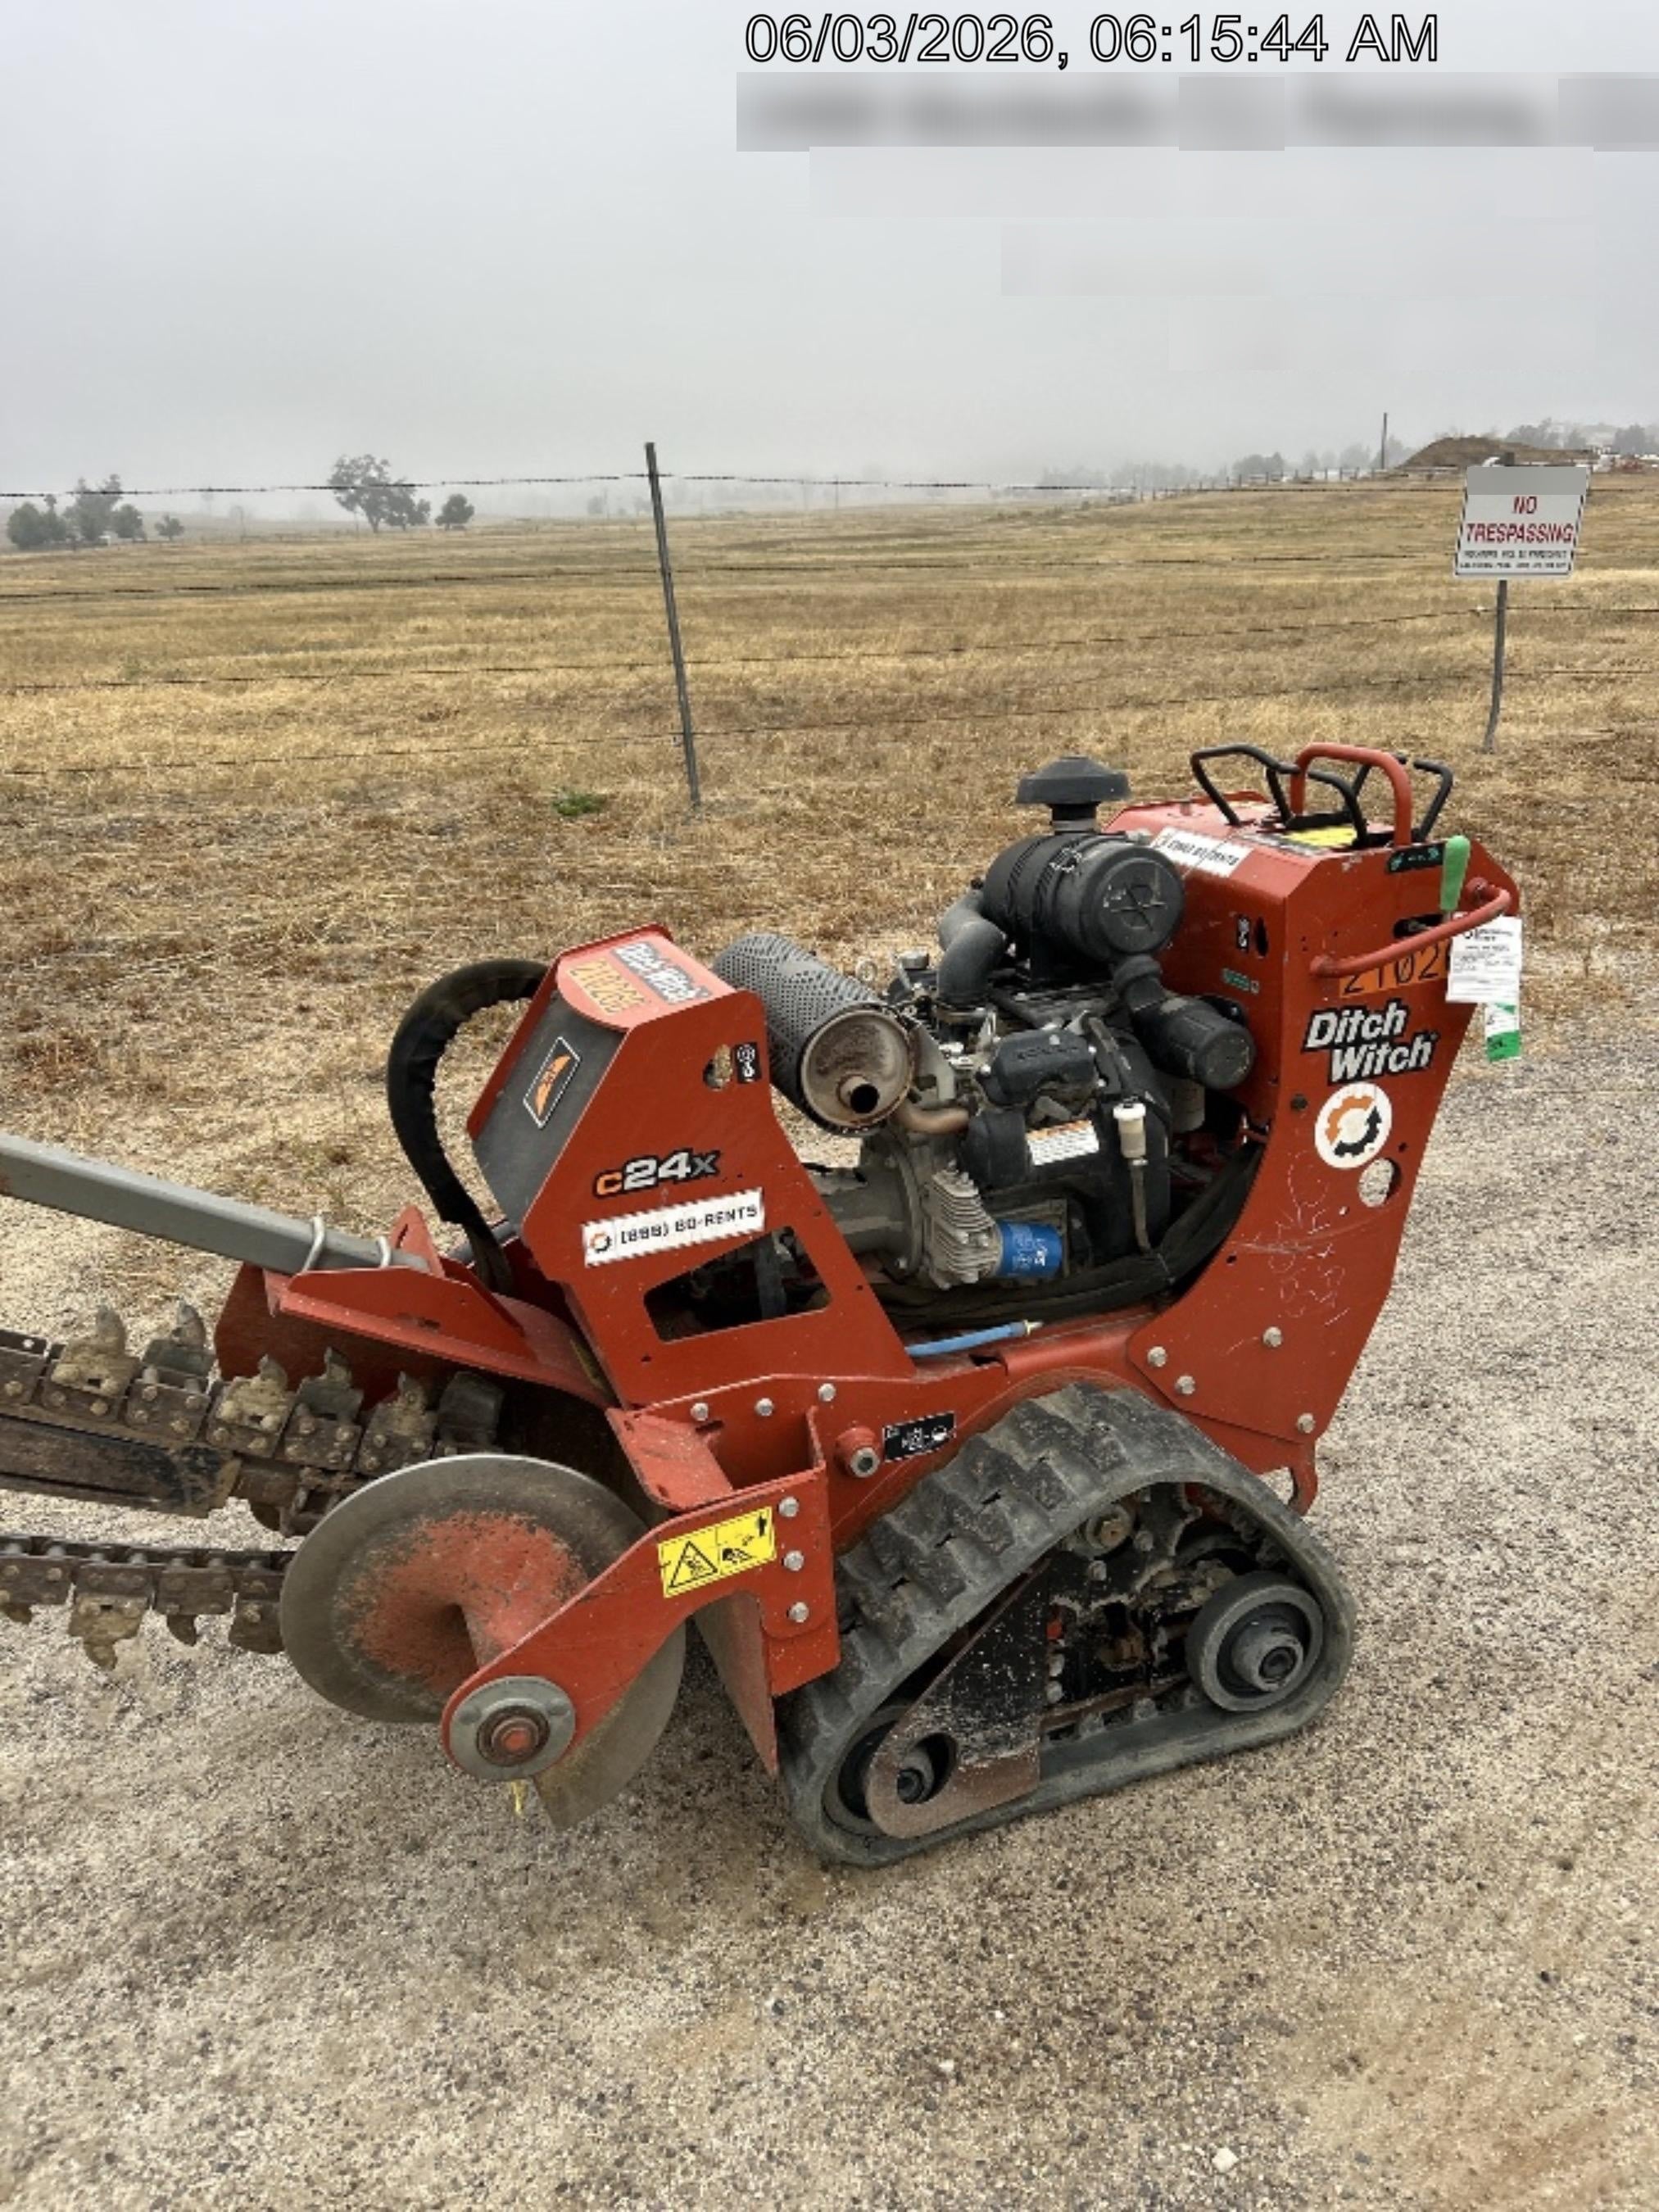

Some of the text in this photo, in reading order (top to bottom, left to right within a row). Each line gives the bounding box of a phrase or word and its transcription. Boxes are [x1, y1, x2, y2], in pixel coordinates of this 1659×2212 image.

[1512, 496, 1538, 514] NO
[1466, 523, 1575, 543] TRESPASSING
[1305, 1001, 1408, 1049] Ditch
[1330, 1034, 1435, 1083] Witch
